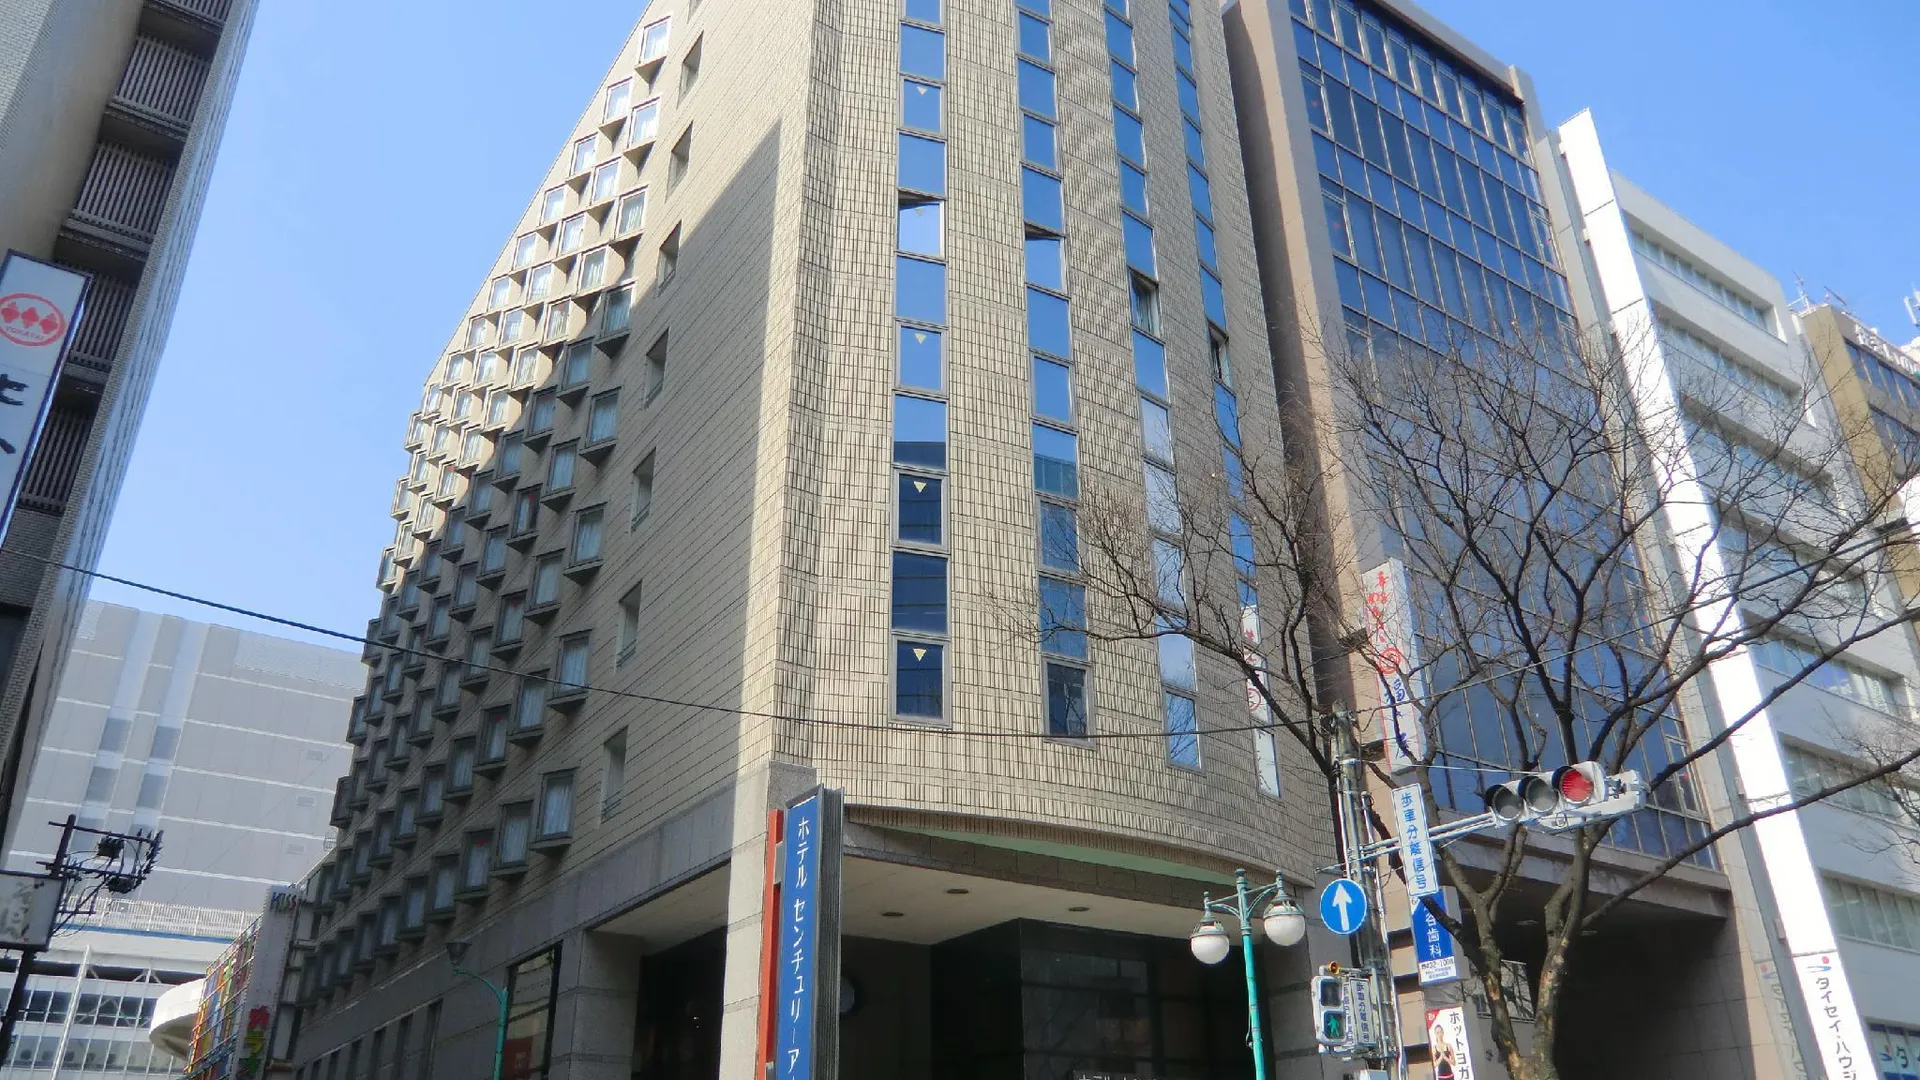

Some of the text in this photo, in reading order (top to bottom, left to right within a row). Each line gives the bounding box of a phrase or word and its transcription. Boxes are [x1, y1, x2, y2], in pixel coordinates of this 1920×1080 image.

[1401, 791, 1427, 890] 歩車分離信号
[786, 816, 810, 1080] ホテル センチュリーア
[1356, 982, 1370, 1042] 歩車分離信号
[1449, 1011, 1470, 1080] ホットヨガ
